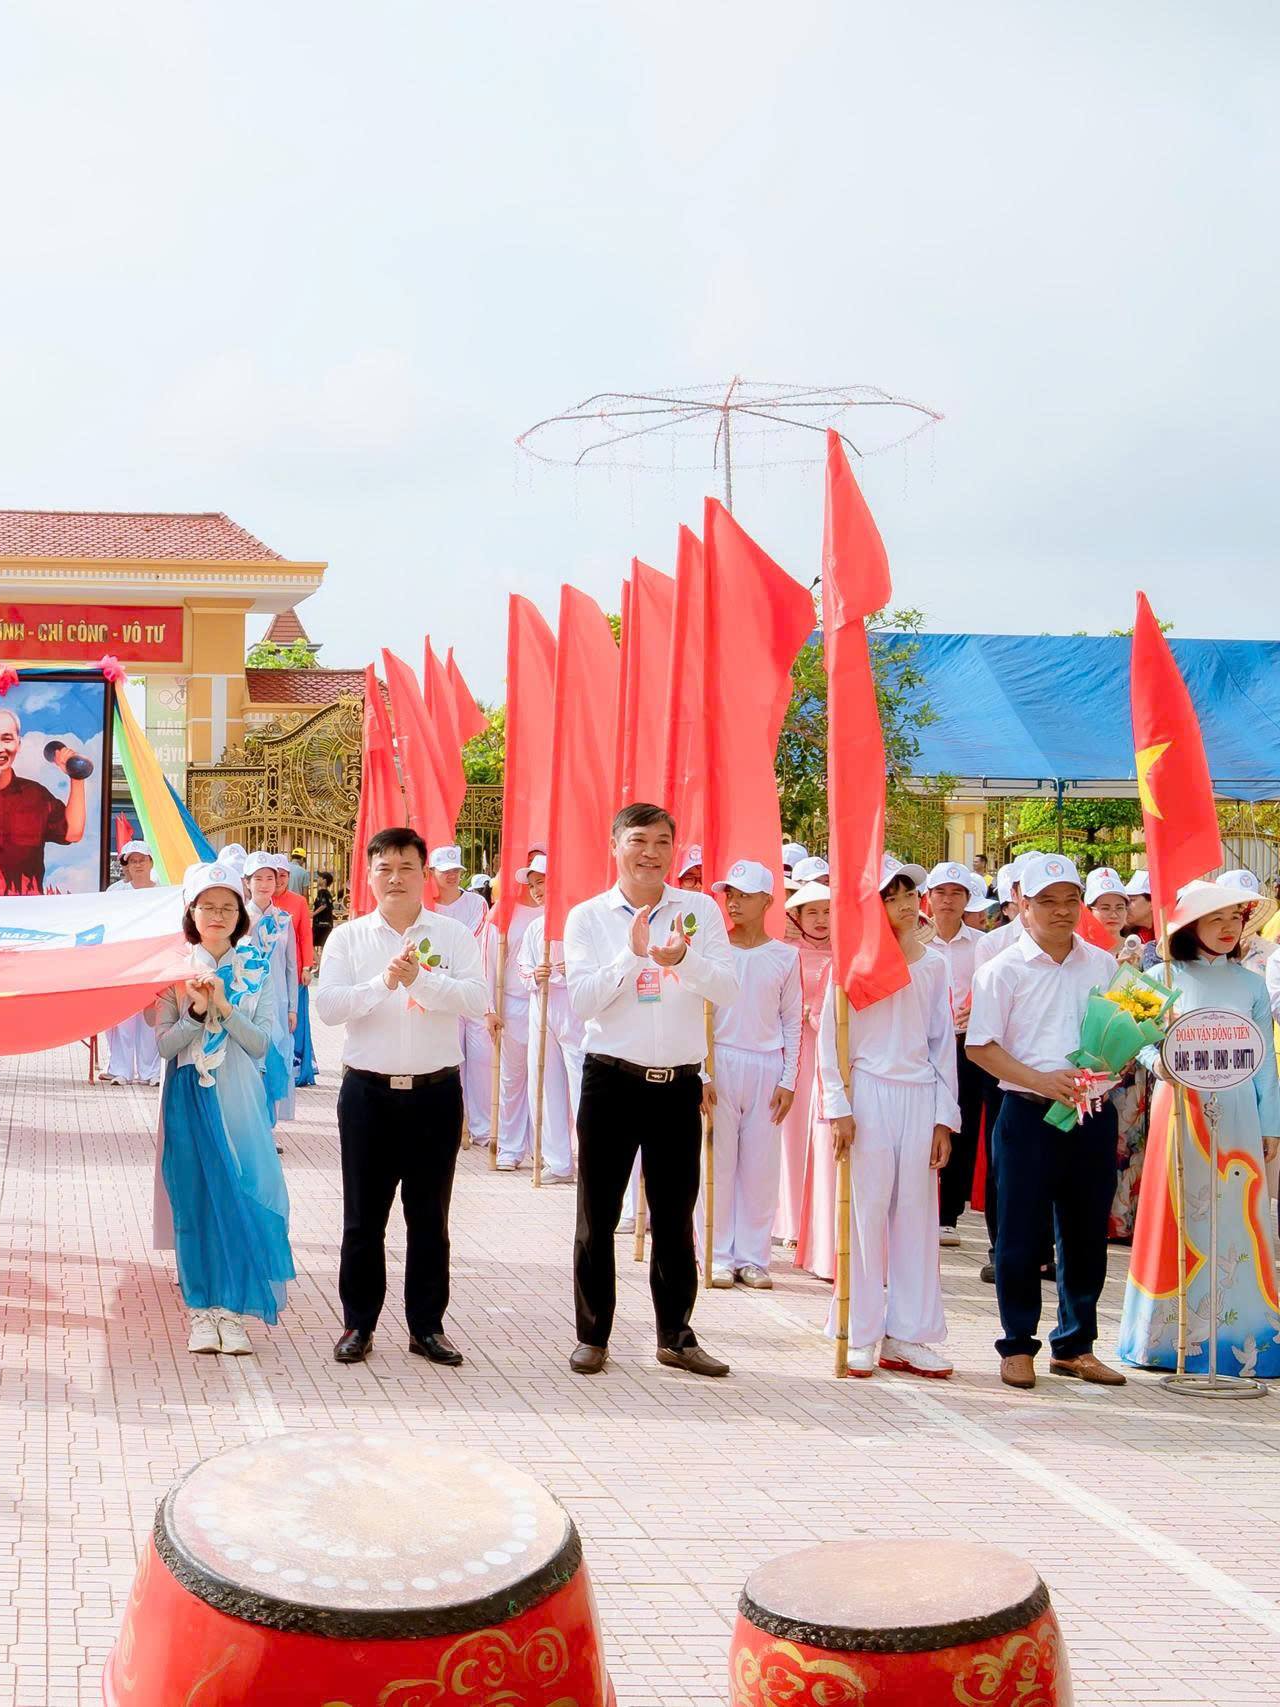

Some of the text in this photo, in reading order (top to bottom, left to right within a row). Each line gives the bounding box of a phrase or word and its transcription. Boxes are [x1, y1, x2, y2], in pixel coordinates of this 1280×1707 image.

[38, 619, 64, 642] CHÍ
[67, 620, 109, 643] CÔNG
[122, 621, 142, 643] VÔ
[145, 623, 166, 643] TƯ
[1176, 1023, 1250, 1044] ĐOÀN VẬN ĐỘNG VIÊN
